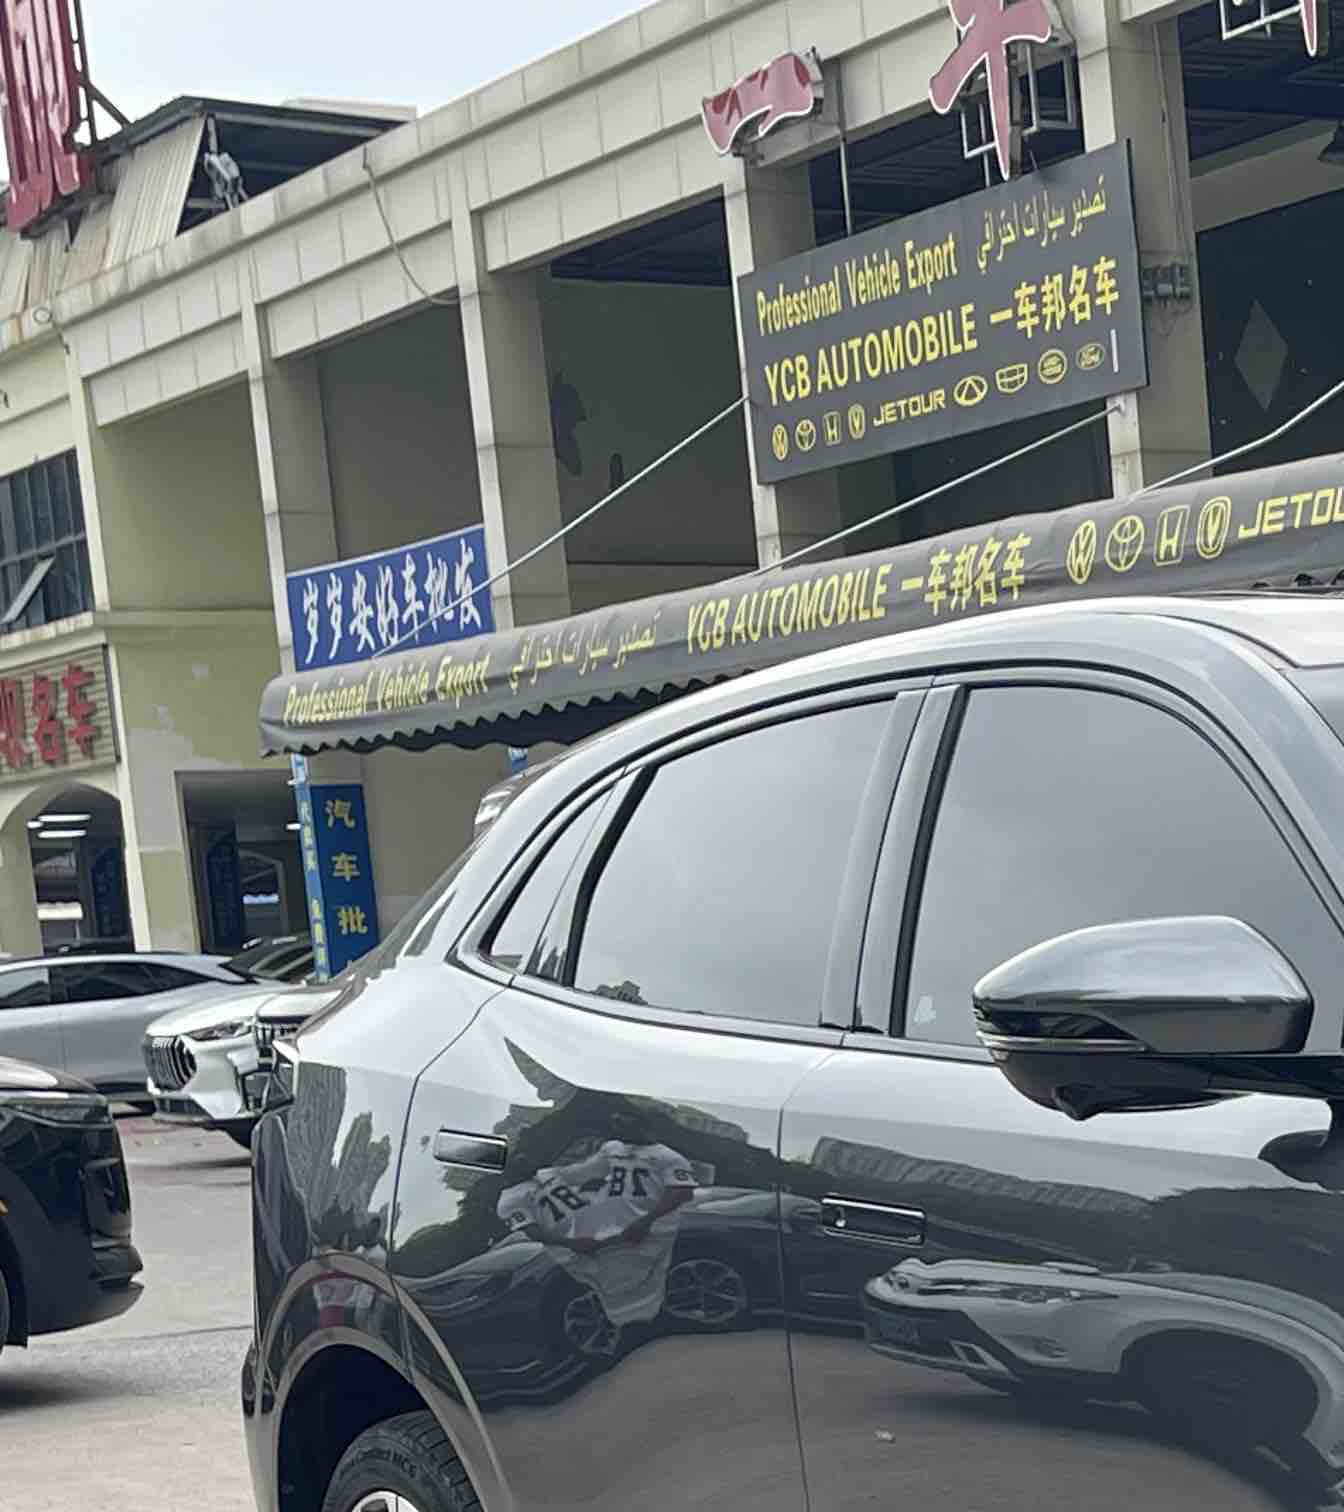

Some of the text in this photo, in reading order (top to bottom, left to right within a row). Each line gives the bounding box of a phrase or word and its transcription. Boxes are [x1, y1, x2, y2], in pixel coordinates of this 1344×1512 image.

[756, 232, 958, 337] Professional Vehicle Export
[990, 255, 1119, 339] 一车邦名车
[764, 303, 978, 407] YCB AUTOMOBILE
[872, 388, 946, 427] JETOUR
[687, 563, 892, 654] YCB AUTOMOBILE
[900, 533, 1032, 618] 一车邦名车
[282, 654, 490, 726] Professional Vehicle Export
[324, 798, 369, 966] 汽车批
